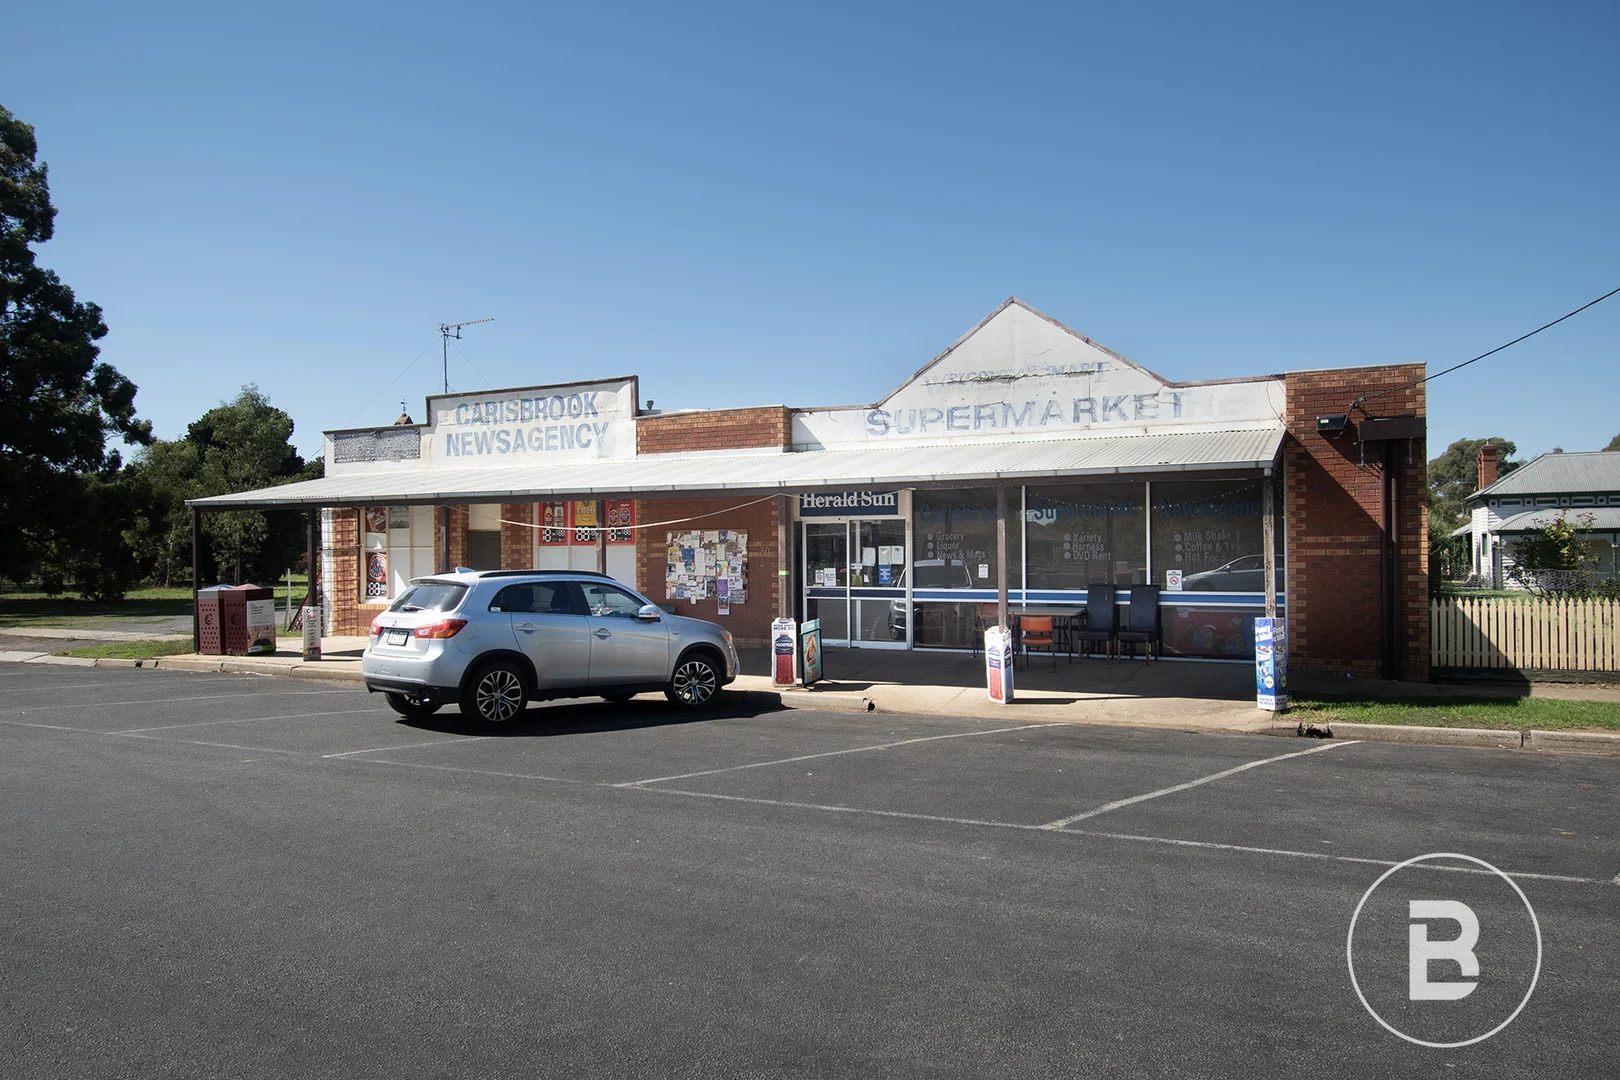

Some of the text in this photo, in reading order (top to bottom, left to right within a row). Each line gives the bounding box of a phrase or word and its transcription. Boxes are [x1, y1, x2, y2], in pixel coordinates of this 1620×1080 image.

[456, 393, 598, 427] CARISBROOK
[866, 391, 1191, 437] SUPERMARKET
[446, 422, 609, 457] NEWSAGENCY
[802, 491, 895, 508] Herald Sun
[577, 507, 595, 515] GOLD
[936, 532, 964, 543] Grocery
[1073, 533, 1102, 543] Variety
[1183, 530, 1232, 542] Milk Shake
[936, 541, 959, 551] Liquor
[1072, 542, 1104, 551] Harness
[1185, 542, 1213, 552] Coffee
[937, 551, 956, 560] News
[966, 550, 986, 560] Mags
[1073, 551, 1111, 560] DVD Rent
[1184, 552, 1226, 562] Hot Food
